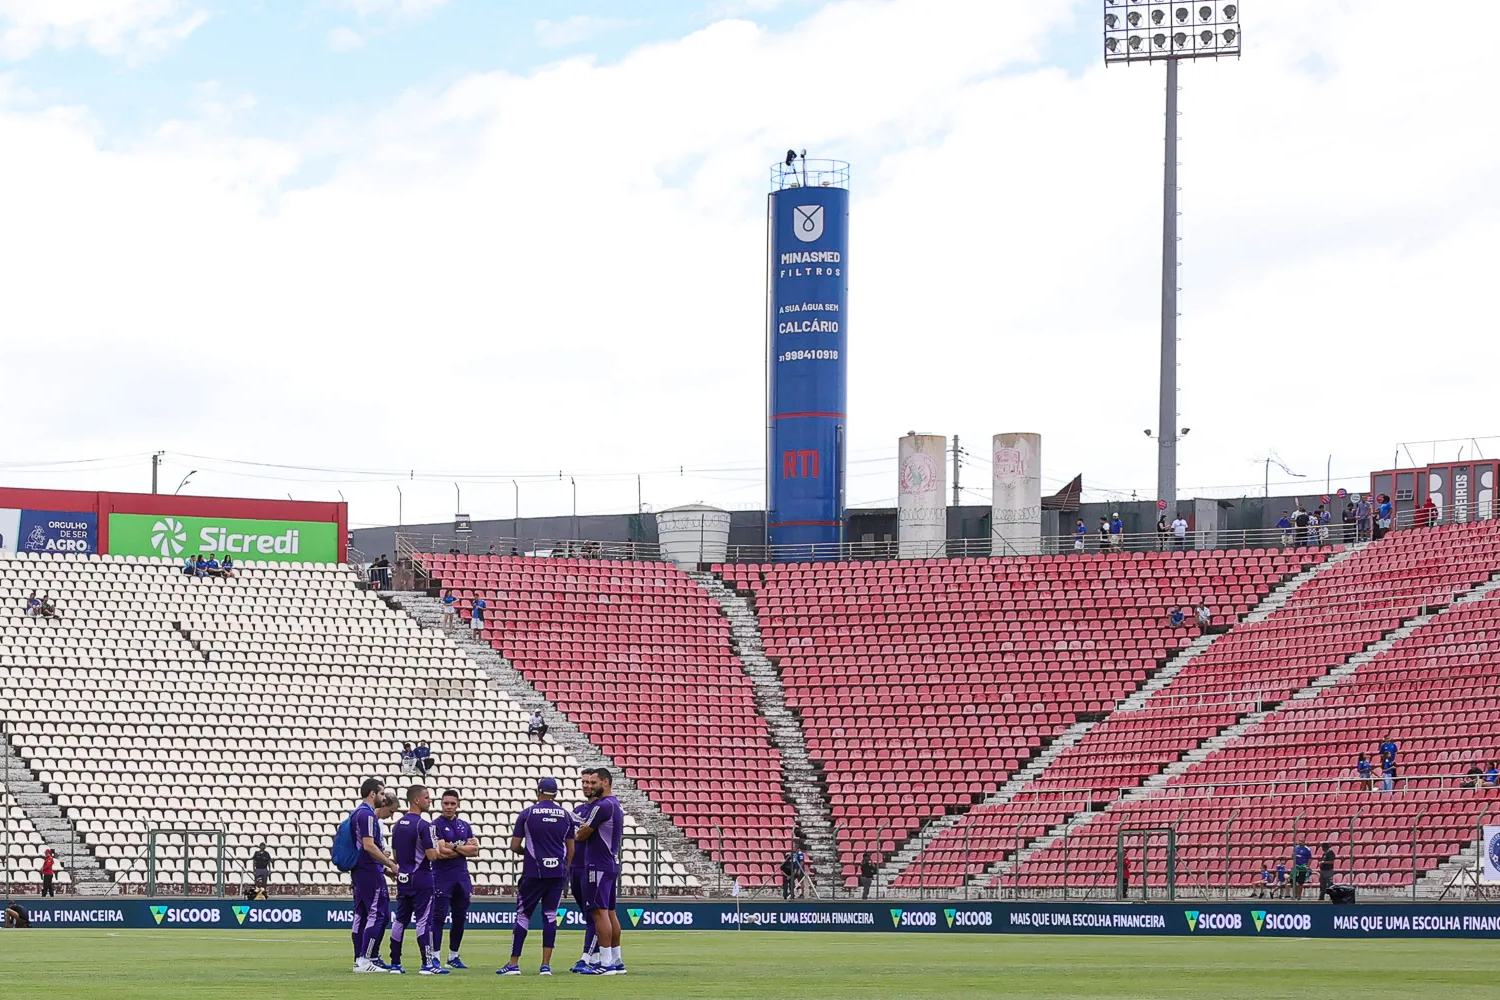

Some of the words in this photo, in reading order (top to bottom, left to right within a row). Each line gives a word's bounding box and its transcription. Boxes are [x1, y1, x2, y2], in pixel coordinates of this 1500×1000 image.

[781, 251, 841, 265] MINASMED
[780, 267, 841, 278] FILTROS
[785, 304, 800, 313] SUA
[801, 302, 824, 312] ÁGUA
[825, 303, 839, 312] SEM
[779, 318, 839, 334] CALCÁRIO
[783, 449, 819, 479] RTI
[48, 521, 88, 530] ORGULHO
[60, 530, 70, 538] DE
[71, 530, 88, 538] SER
[199, 527, 299, 554] Sicredi
[45, 539, 88, 551] AGRO
[54, 909, 124, 922] FINANCEIRA
[167, 908, 221, 923] SICOOB
[249, 908, 302, 923] SICOOB
[327, 910, 355, 922] MAIS
[642, 911, 693, 925] SICOOB
[721, 912, 749, 924] MAIS
[753, 912, 777, 925] QUE
[780, 912, 799, 924] UMA
[800, 912, 831, 924] ESCOLHA
[832, 912, 874, 925] FINANCEIRA
[901, 911, 937, 926] SICOOB
[955, 911, 993, 927] SICOOB
[1010, 912, 1031, 925] MAIS
[1032, 913, 1050, 927] QUE
[1051, 913, 1071, 926] UMA
[1072, 914, 1112, 927] ESCOLHA
[1113, 915, 1166, 928] FINANCEIRA
[1198, 913, 1242, 930] SICOOB
[1266, 914, 1312, 931] SICOOB
[1333, 916, 1359, 930] MAIS
[1360, 916, 1383, 932] QUE
[1385, 916, 1411, 930] UMA
[1412, 916, 1461, 931] ESCOLHA
